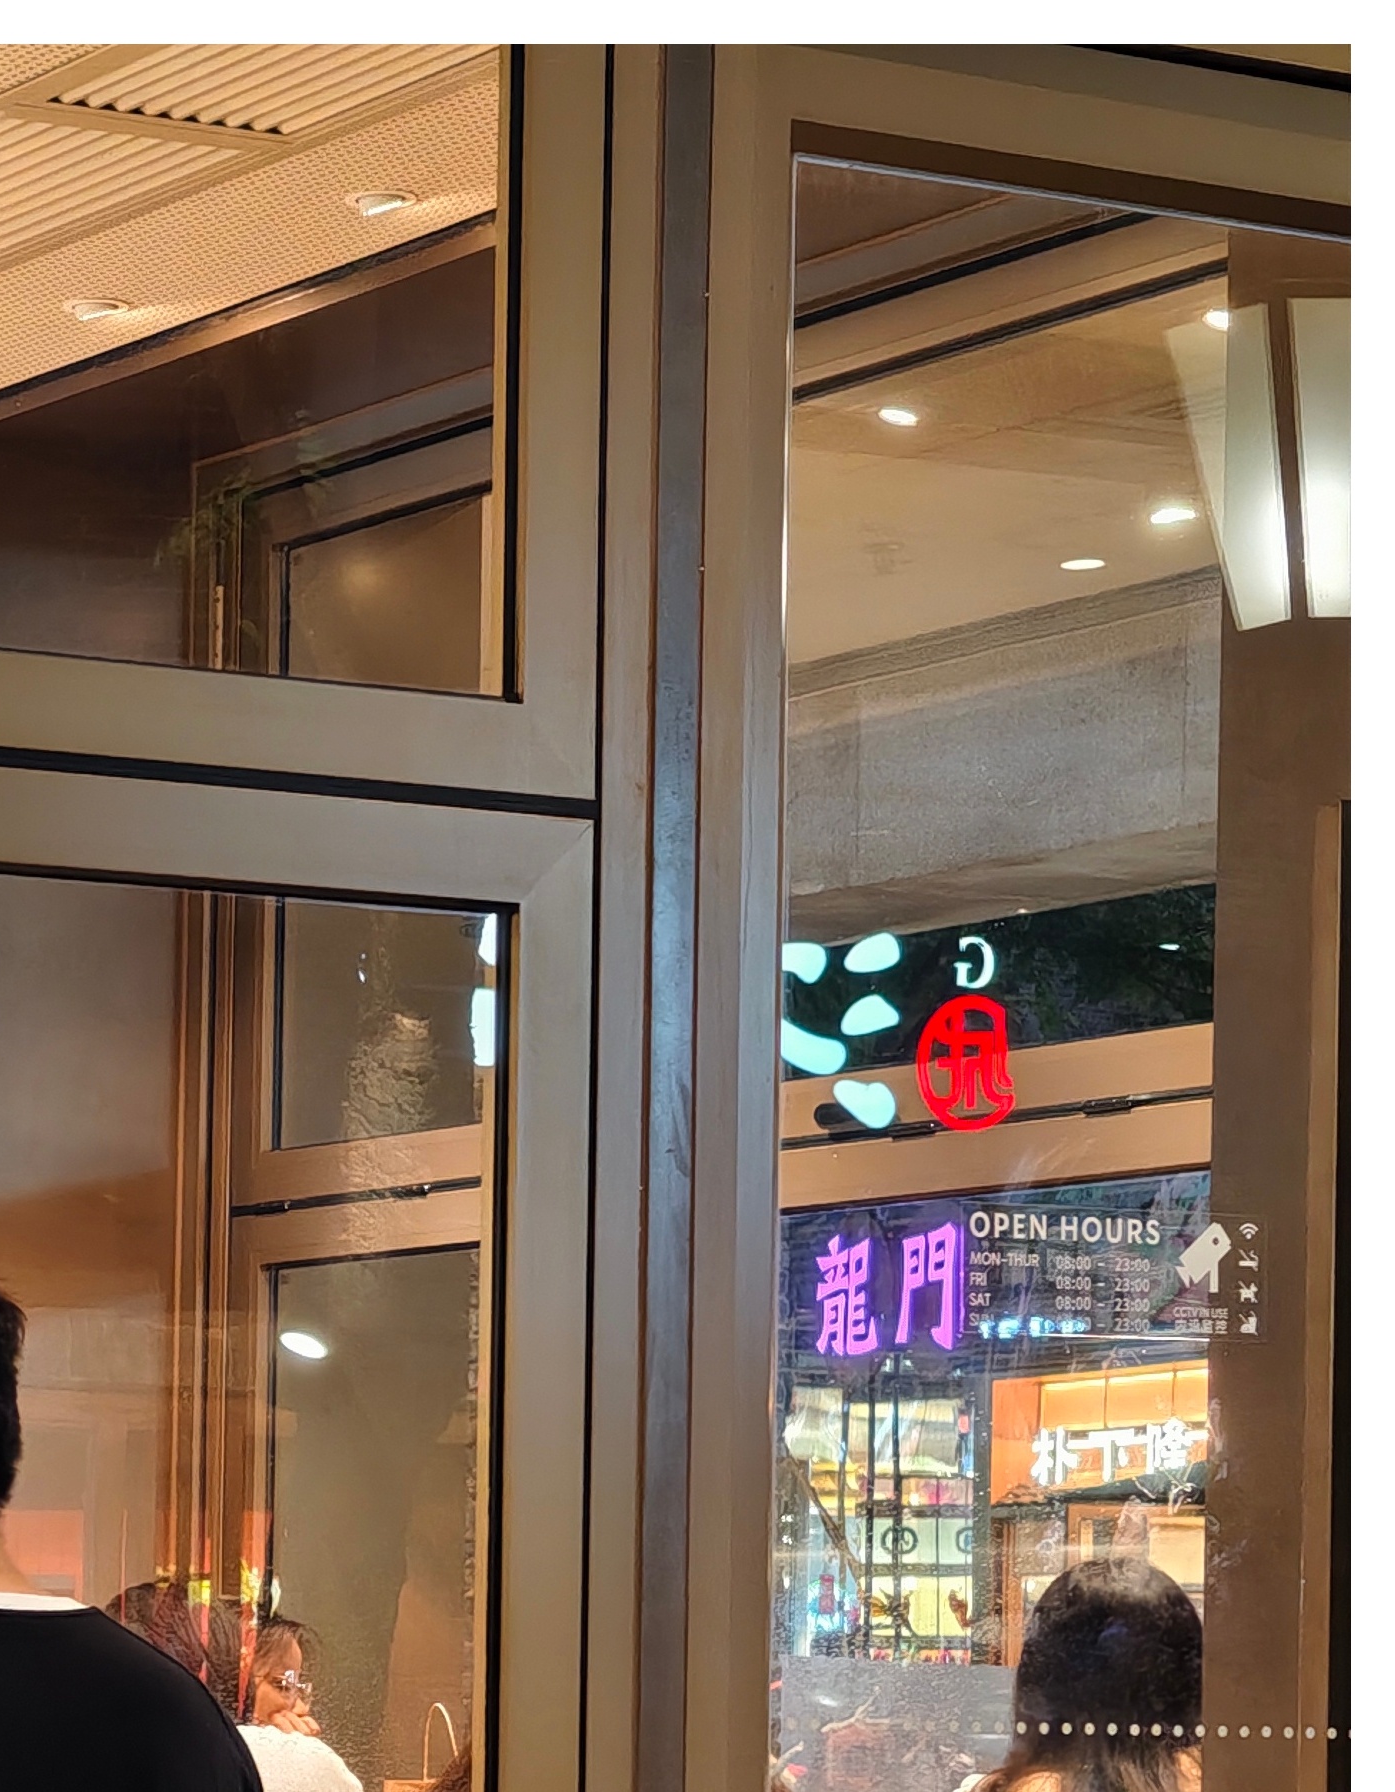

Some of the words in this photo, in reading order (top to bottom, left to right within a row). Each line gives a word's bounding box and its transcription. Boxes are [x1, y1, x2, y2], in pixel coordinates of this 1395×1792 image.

[969, 1210, 1048, 1241] OPEN
[1061, 1215, 1161, 1245] HOURS
[815, 1222, 957, 1356] 龍門
[969, 1272, 988, 1287] FRI
[1114, 1278, 1150, 1292] 23:00
[969, 1293, 991, 1307] SAT
[1114, 1298, 1151, 1312] 23:00
[1114, 1317, 1151, 1332] 23:00
